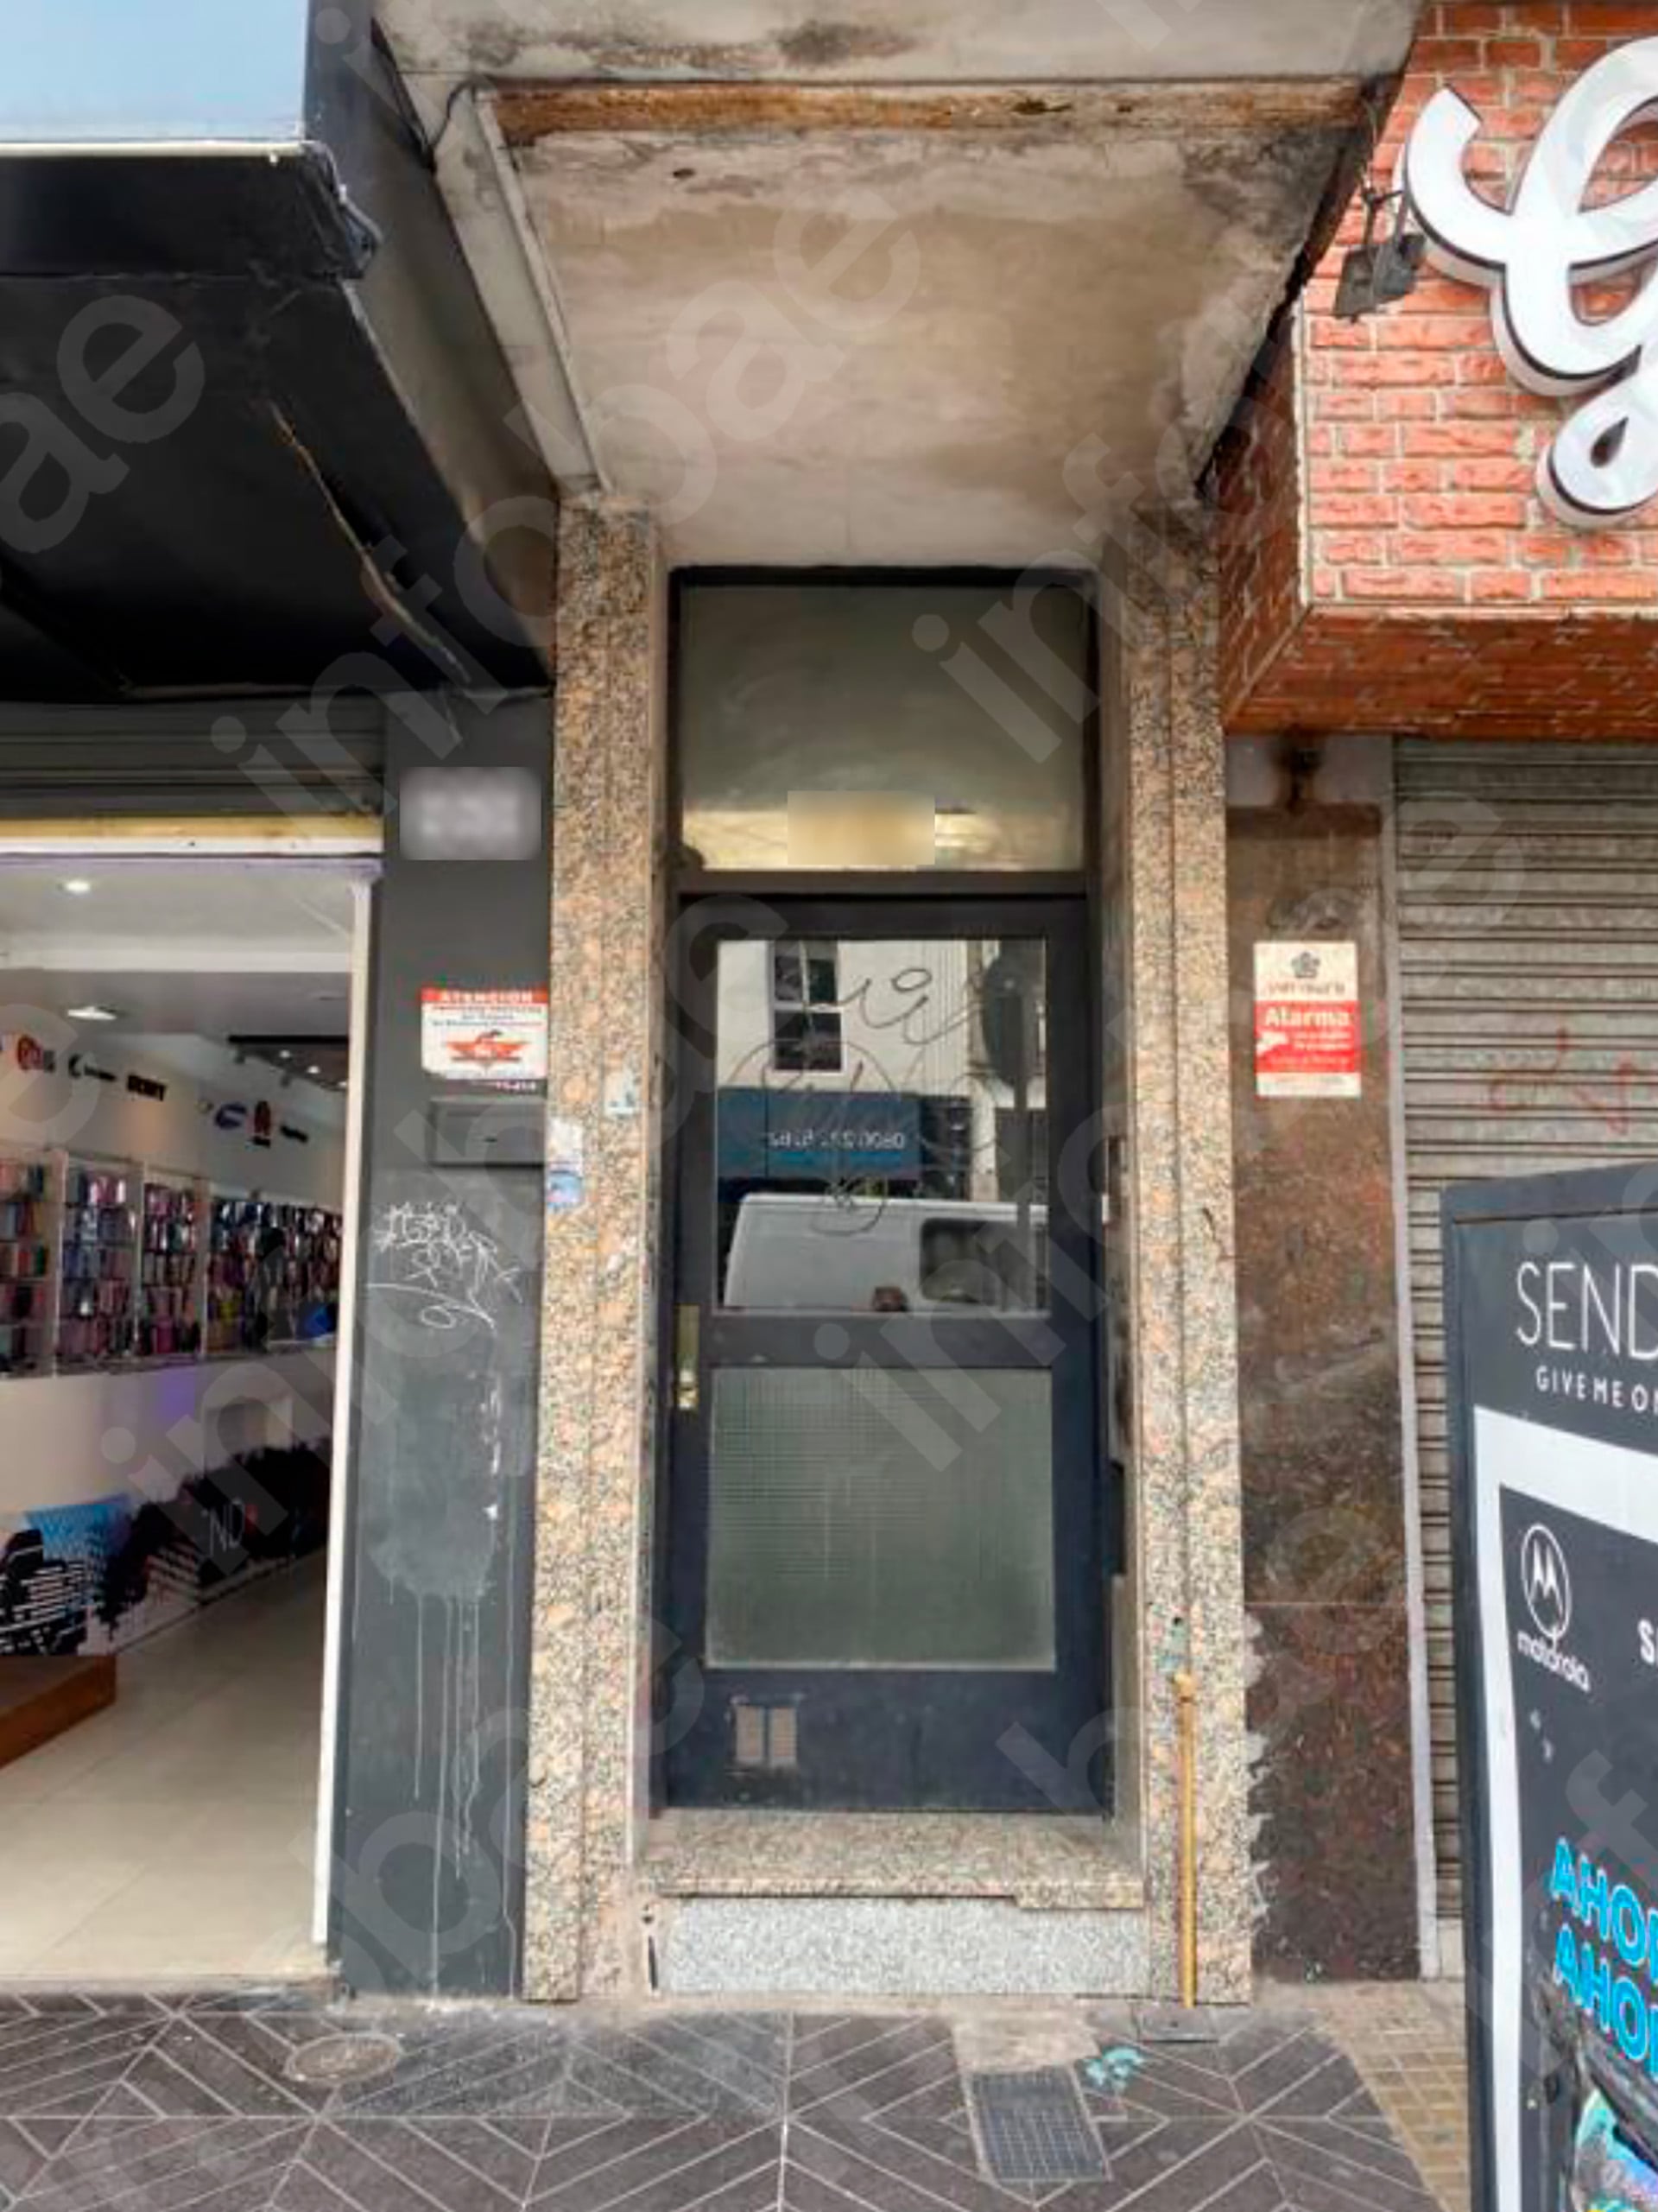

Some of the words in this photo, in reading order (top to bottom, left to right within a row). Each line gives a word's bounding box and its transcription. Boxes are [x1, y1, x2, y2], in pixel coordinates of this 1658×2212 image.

[1265, 1006, 1350, 1025] Alarma
[1535, 1365, 1586, 1400] GIVE
[1592, 1377, 1624, 1409] ME
[1517, 1630, 1591, 1692] motorola
